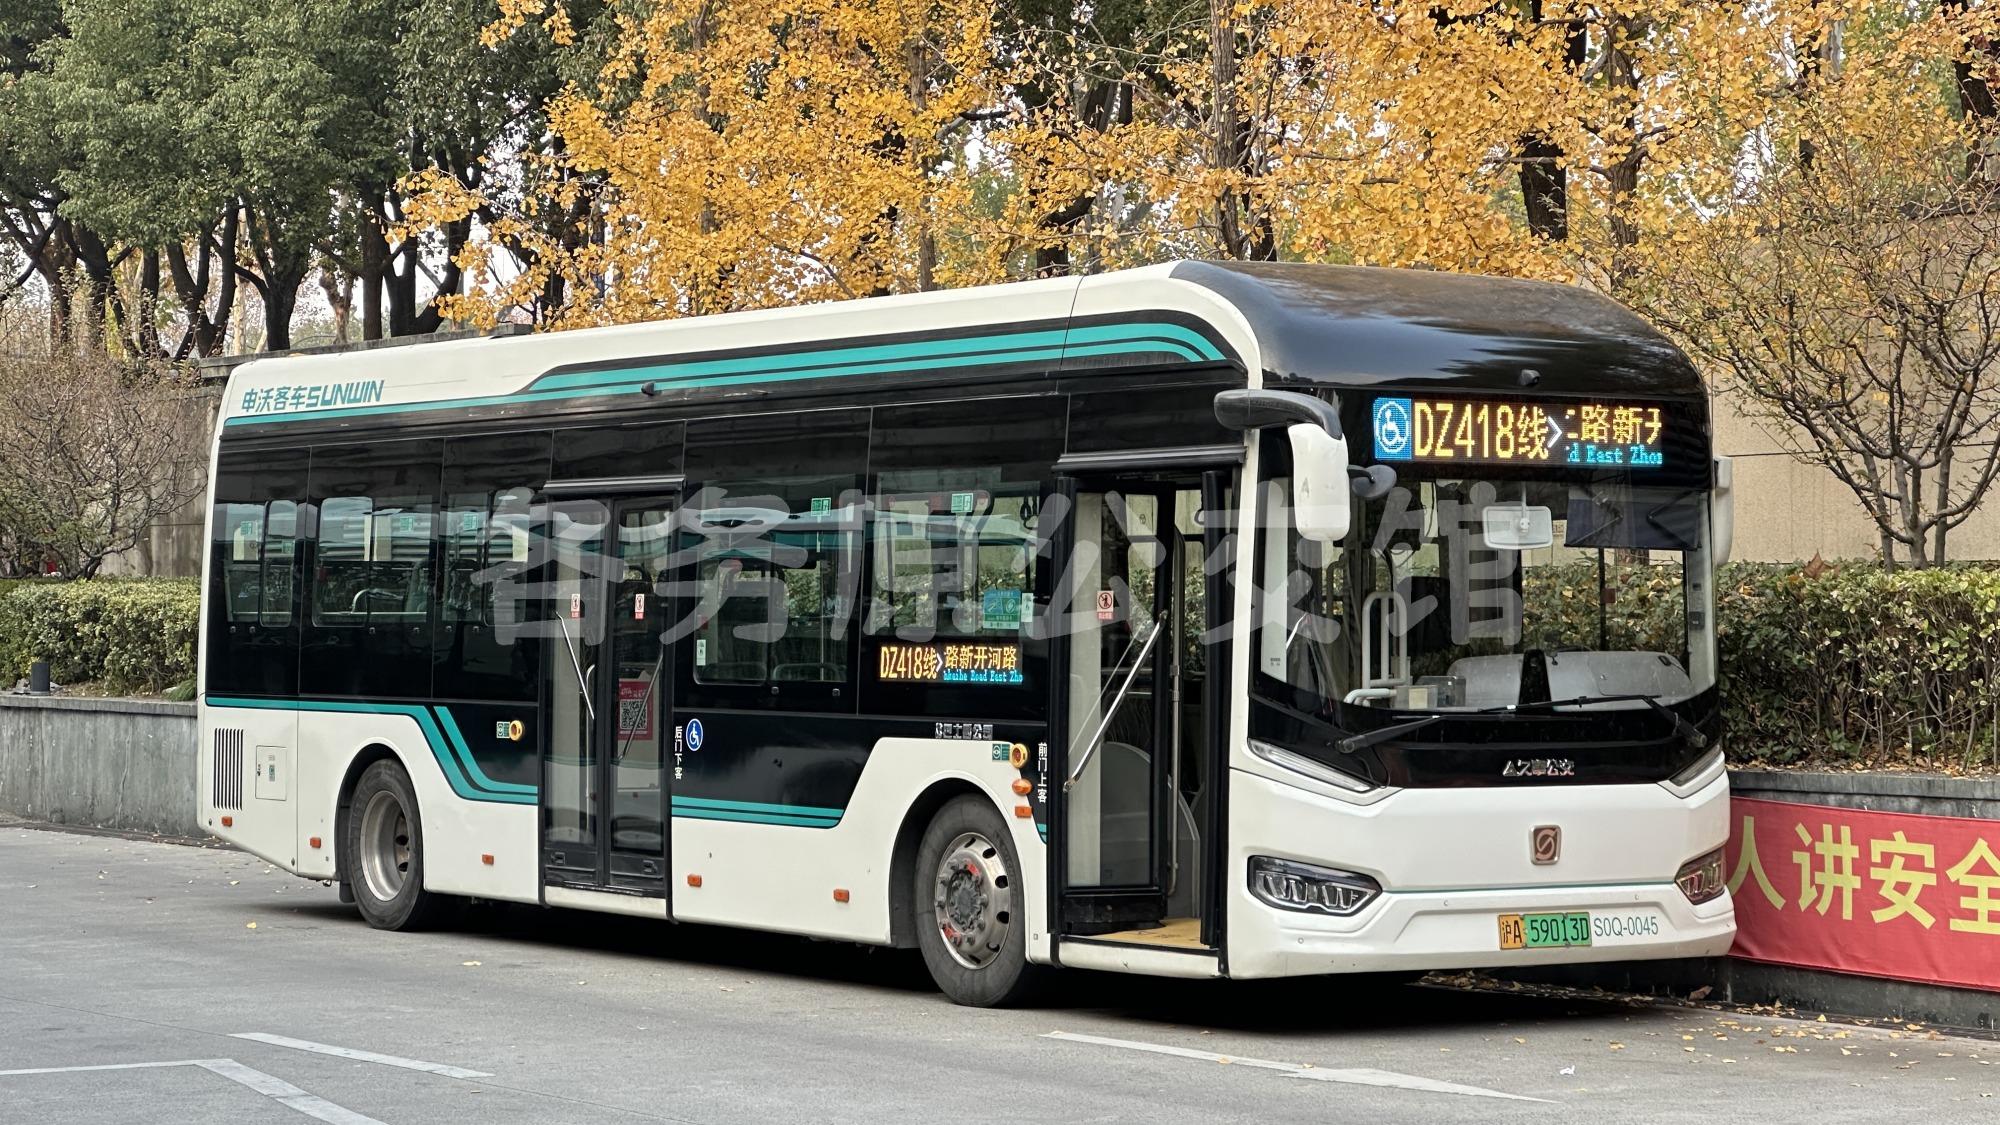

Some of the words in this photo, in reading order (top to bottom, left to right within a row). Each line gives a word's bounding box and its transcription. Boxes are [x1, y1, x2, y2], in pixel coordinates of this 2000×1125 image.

[1414, 403, 1549, 460] DZ418线
[1586, 444, 1623, 463] East
[880, 646, 937, 679] DZ418线
[944, 645, 1017, 670] 路新开河路
[970, 669, 988, 682] Road
[990, 669, 1007, 683] East
[675, 726, 683, 780] 后门下客
[1038, 742, 1047, 803] 前门上客
[1501, 920, 1523, 944] 沪A
[1530, 917, 1590, 943] 59013D
